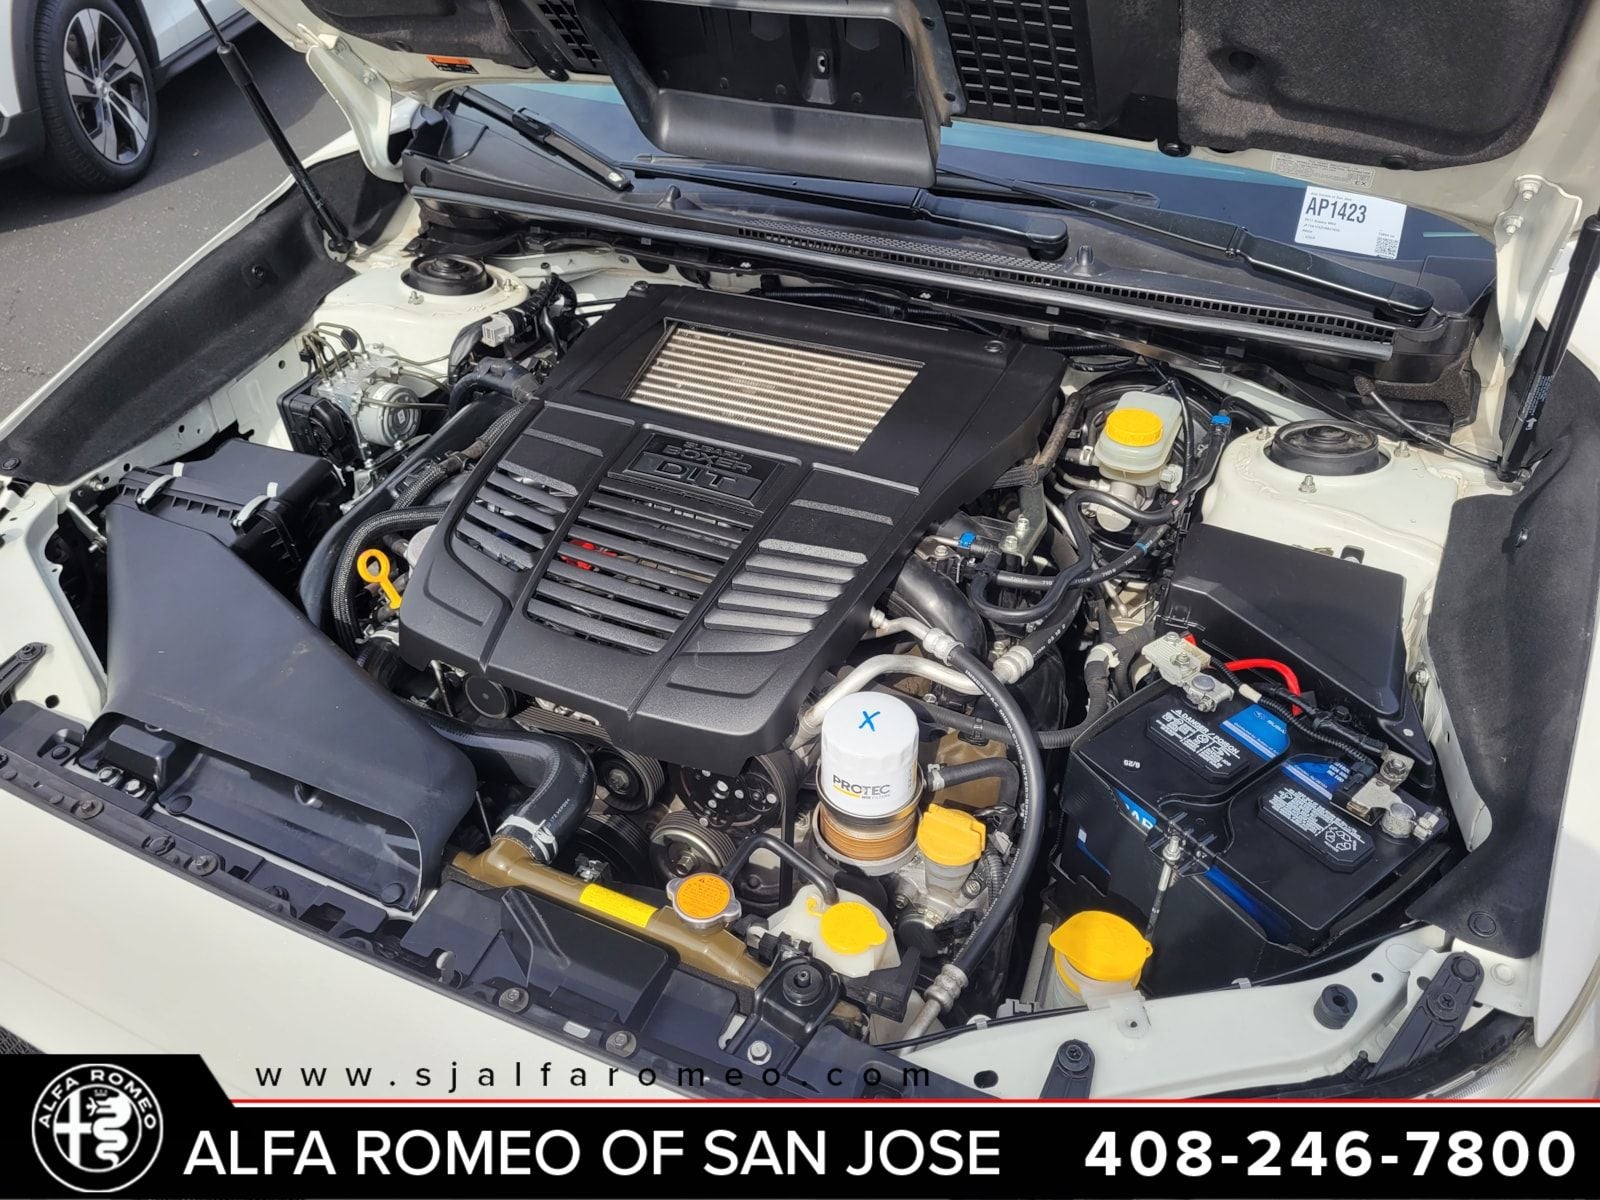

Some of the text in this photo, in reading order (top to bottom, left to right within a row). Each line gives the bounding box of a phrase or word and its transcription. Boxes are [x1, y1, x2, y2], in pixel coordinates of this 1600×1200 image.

[1305, 197, 1367, 224] AP1423
[663, 445, 753, 474] BOXER
[654, 461, 738, 488] DIT
[1181, 713, 1211, 735] DANGER
[1213, 734, 1241, 755] POISON
[833, 774, 892, 795] PROTEC
